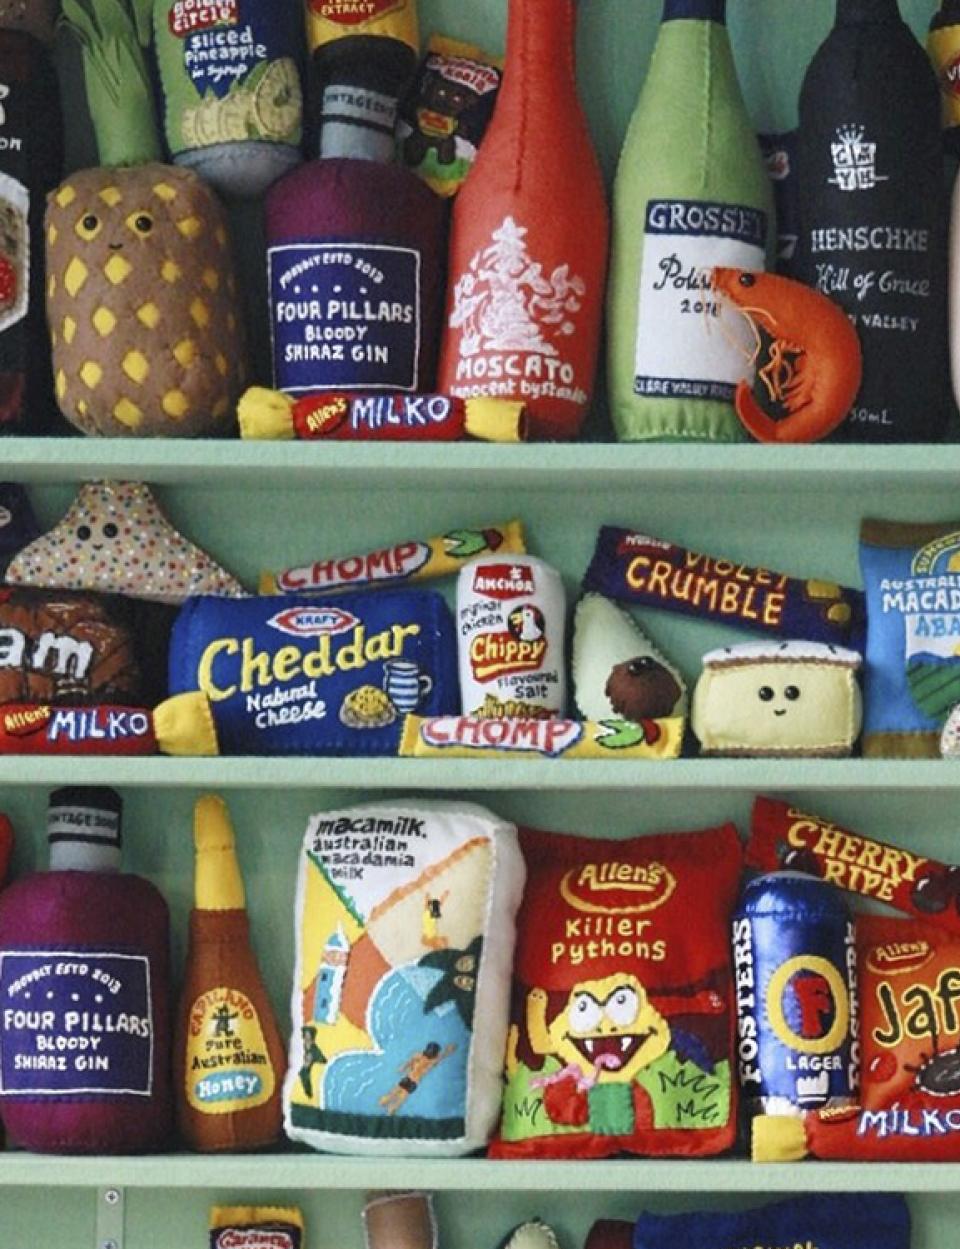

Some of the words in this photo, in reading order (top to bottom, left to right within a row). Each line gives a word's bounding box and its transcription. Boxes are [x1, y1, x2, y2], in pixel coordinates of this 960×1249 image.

[811, 227, 929, 252] HENSCHKE
[854, 271, 875, 300] of
[276, 300, 322, 322] FOUR
[327, 300, 413, 323] PILLARS
[305, 325, 368, 342] BLOODY
[285, 343, 344, 363] SHIRAZ
[351, 344, 388, 363] GIN
[456, 355, 574, 384] MOSCATO
[352, 396, 449, 429] MILKO
[277, 541, 419, 591] CHOMP
[626, 556, 785, 624] CRUMBLE
[471, 634, 545, 662] Chippy
[198, 624, 420, 701] Cheddar
[247, 681, 316, 714] Natural
[48, 711, 148, 740] MILKO
[424, 718, 573, 752] CHOMP
[317, 815, 427, 839] macamilk.
[313, 836, 408, 852] australian
[788, 820, 927, 882] CHERRY
[578, 862, 661, 891] Allen's
[824, 858, 899, 900] RIPE
[565, 918, 650, 938] Killer
[3, 1010, 55, 1031] FOUR
[65, 1011, 149, 1037] PILLARS
[36, 1035, 101, 1050] BLOODY
[14, 1056, 67, 1070] SHIRAZ
[75, 1056, 109, 1070] GIN
[786, 1056, 842, 1070] LAGER
[197, 1073, 258, 1098] Honey
